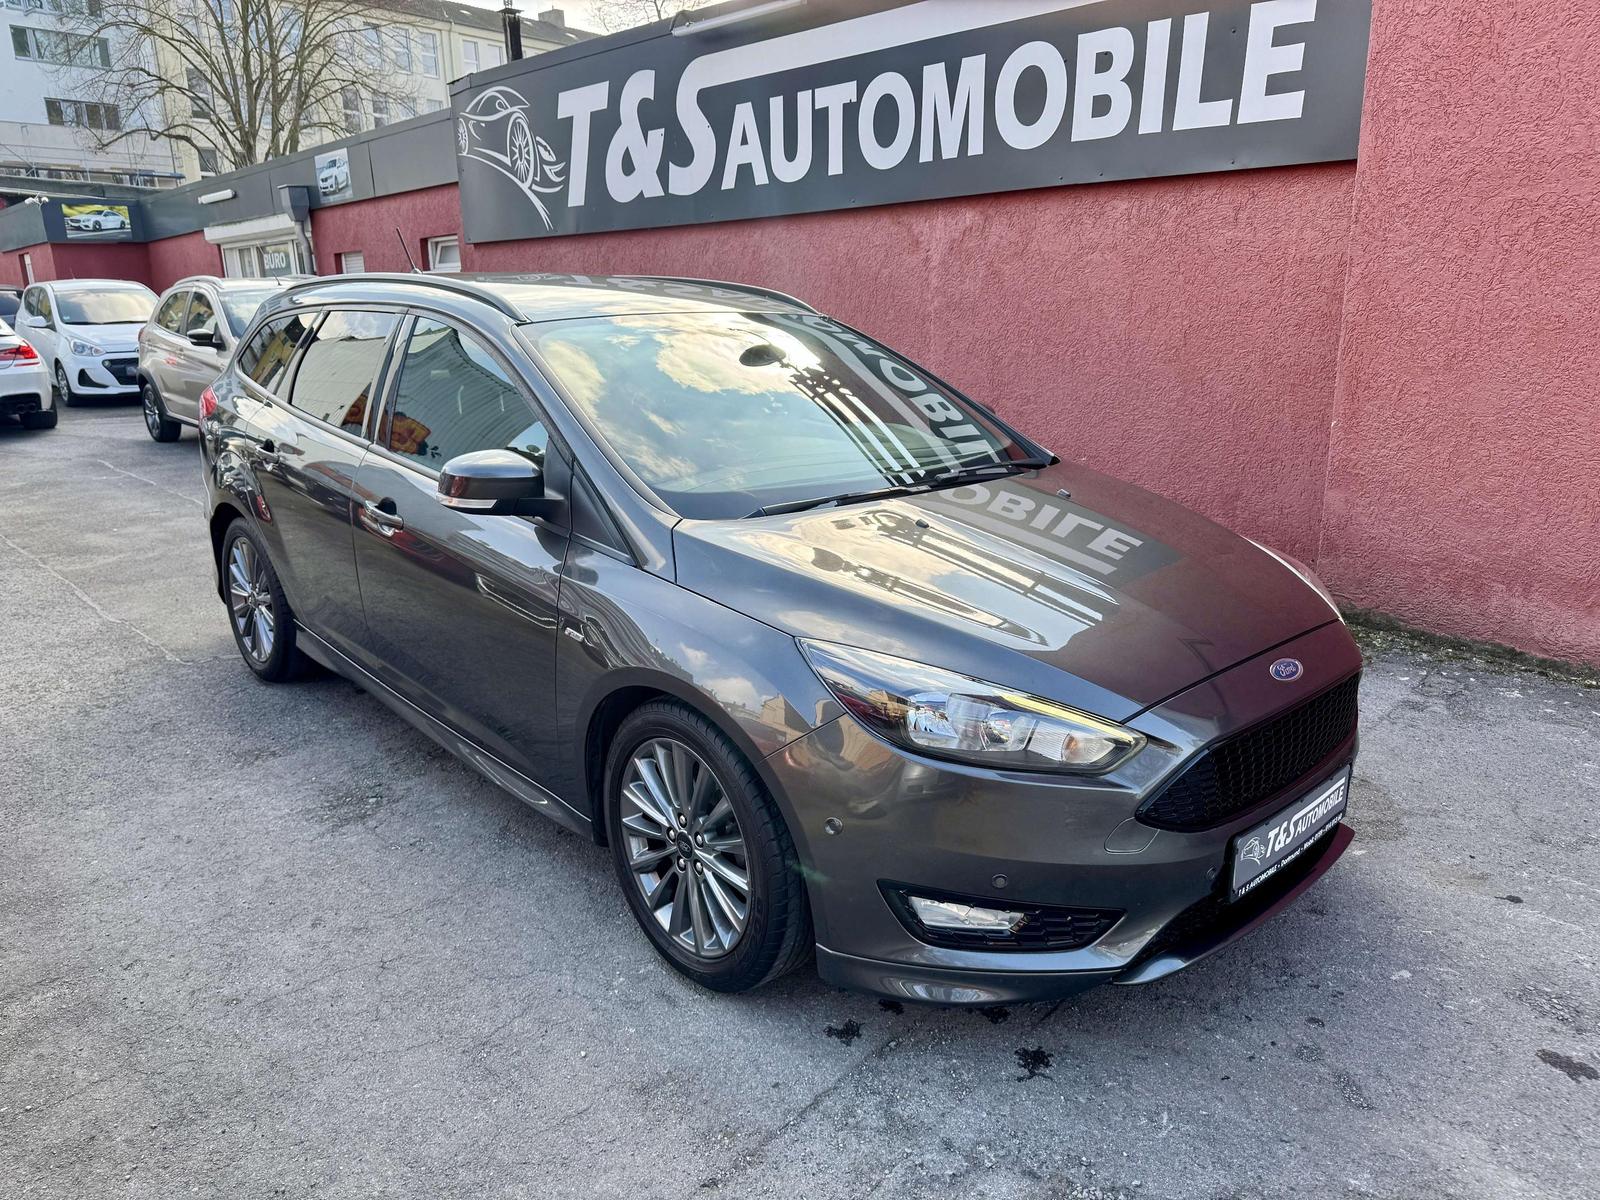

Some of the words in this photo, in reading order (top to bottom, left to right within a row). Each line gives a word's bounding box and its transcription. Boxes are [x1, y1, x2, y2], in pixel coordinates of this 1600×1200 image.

[557, 55, 717, 208] T&S
[721, 0, 1317, 190] AUTOMOBILE
[1277, 662, 1297, 677] Ford
[1266, 814, 1295, 858] T&S
[1295, 785, 1345, 838] AUTOMOBILE
